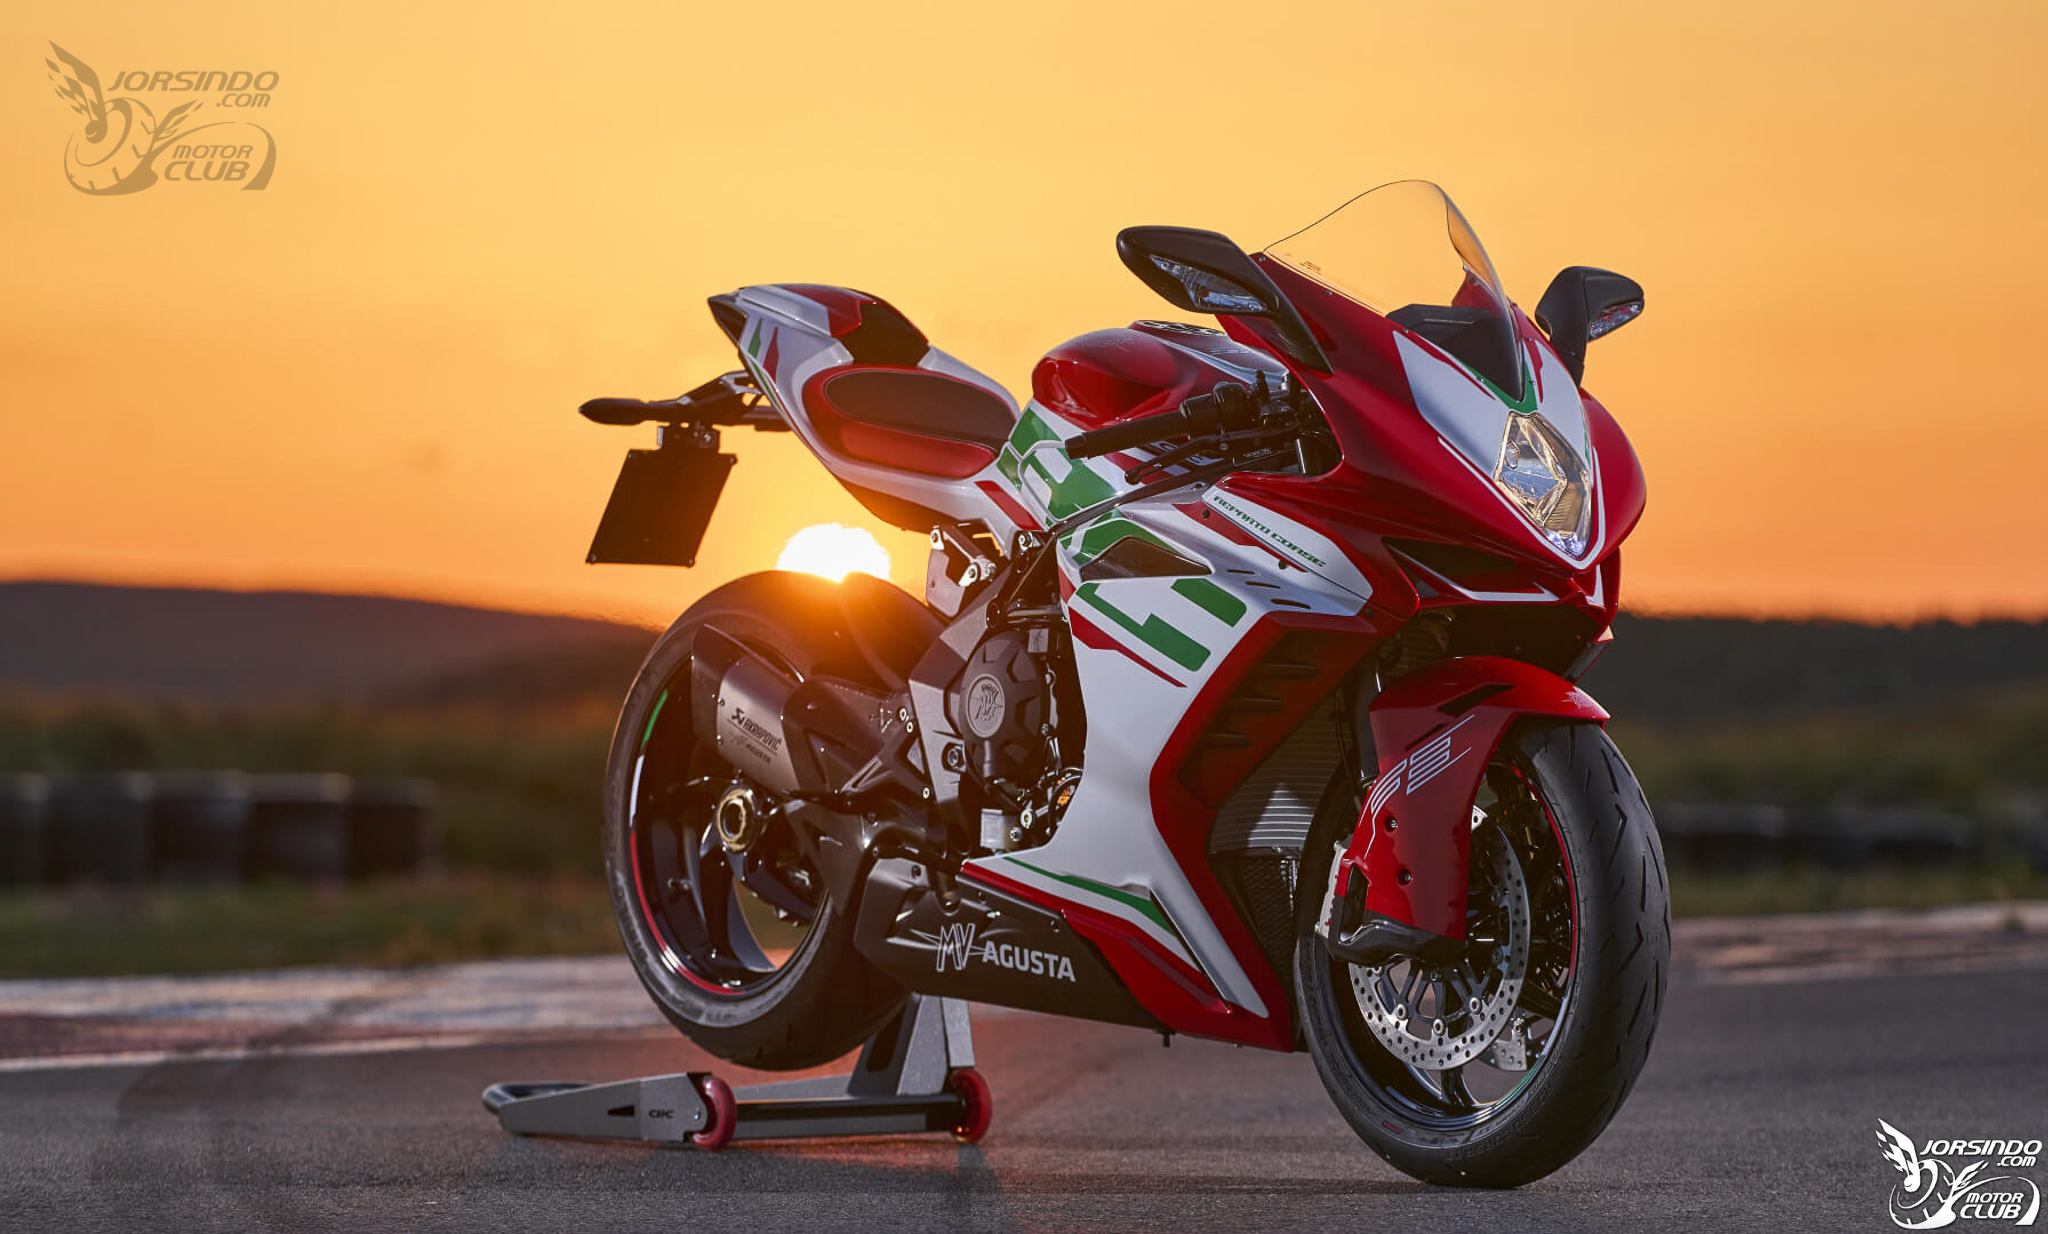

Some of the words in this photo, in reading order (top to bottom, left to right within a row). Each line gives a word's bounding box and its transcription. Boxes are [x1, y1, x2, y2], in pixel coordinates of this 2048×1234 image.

[1213, 495, 1271, 535] REPARTO
[1270, 532, 1327, 568] CORSE
[936, 922, 976, 973] MV
[981, 940, 1077, 982] AGUSTA
